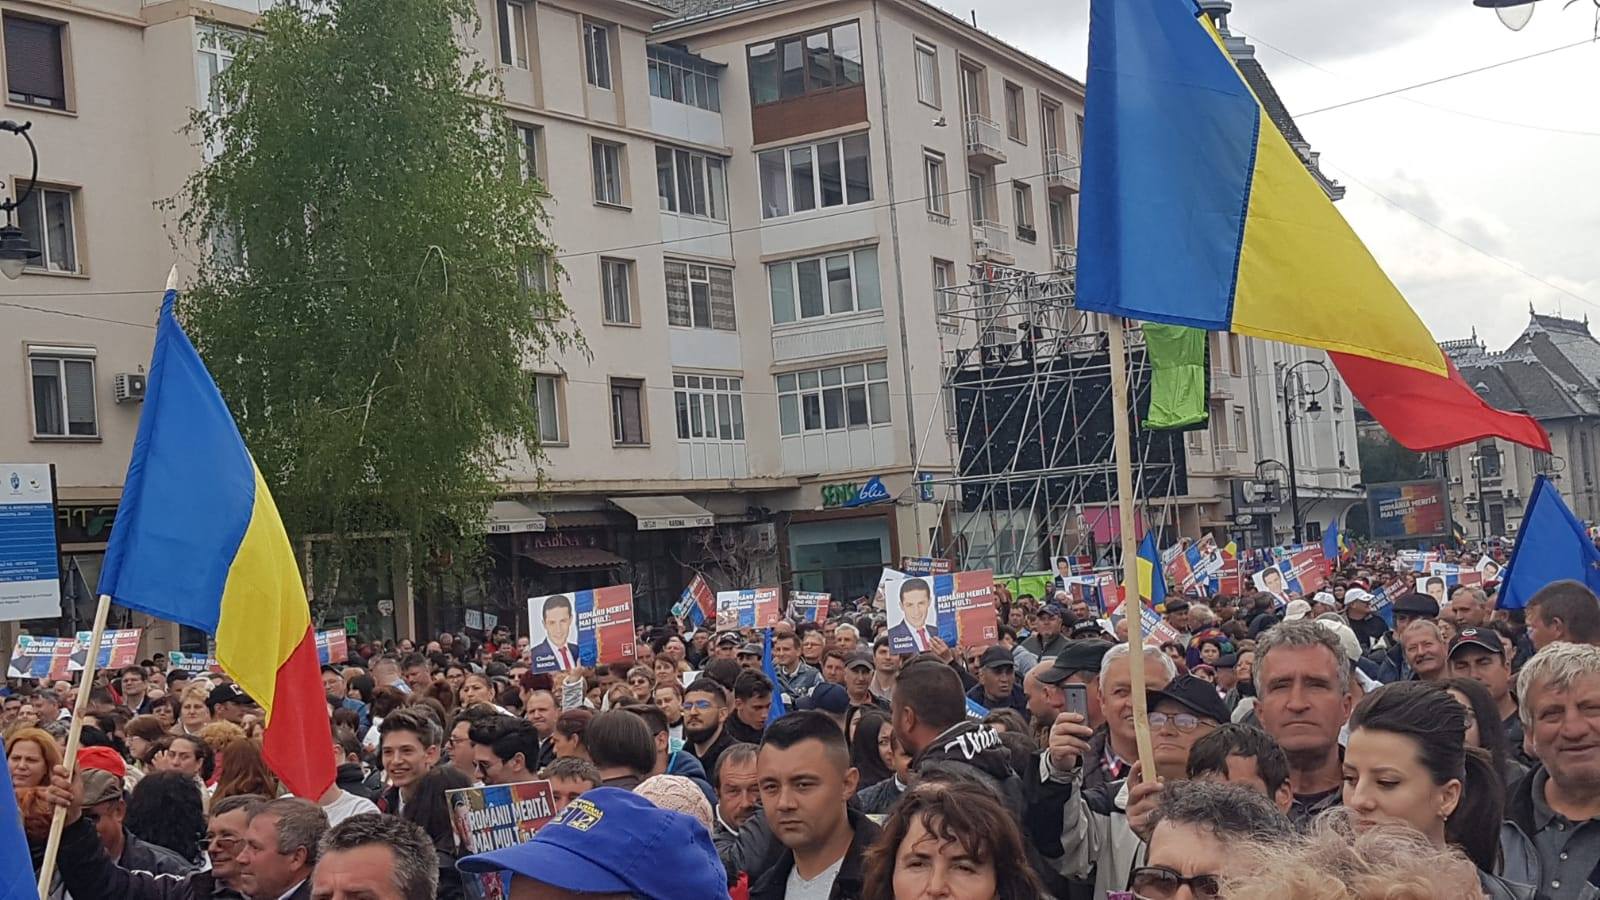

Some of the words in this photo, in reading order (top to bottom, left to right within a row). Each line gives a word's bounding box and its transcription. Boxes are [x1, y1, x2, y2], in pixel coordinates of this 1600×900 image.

[469, 803, 512, 831] ROMÂNII
[511, 789, 552, 822] MERITĂ
[473, 831, 494, 854] MAI
[493, 826, 522, 849] MULT
